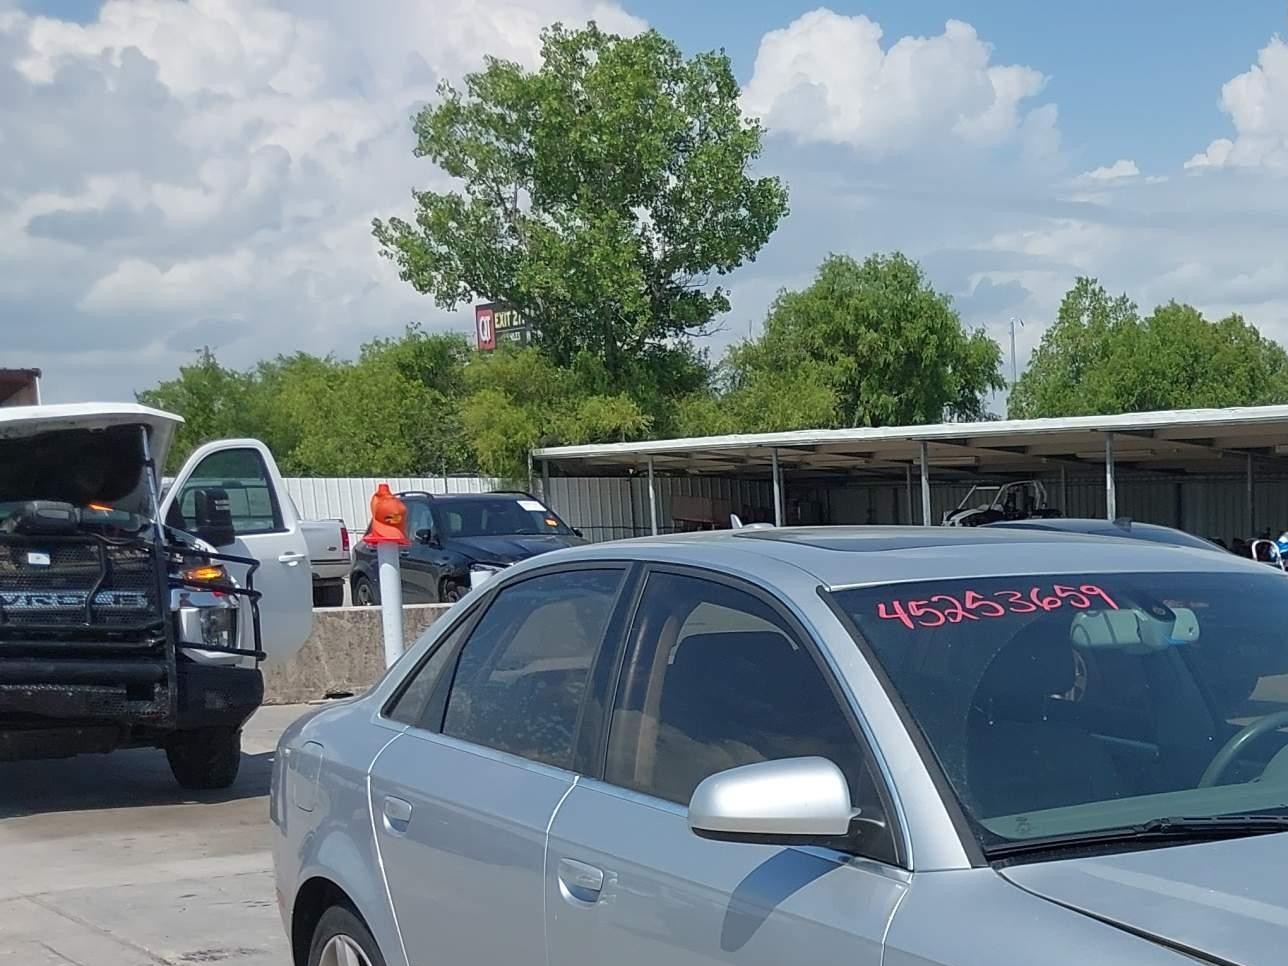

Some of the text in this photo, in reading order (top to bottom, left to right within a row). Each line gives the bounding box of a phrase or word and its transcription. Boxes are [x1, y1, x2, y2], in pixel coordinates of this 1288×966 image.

[479, 315, 491, 342] QT
[494, 310, 511, 329] EXIT
[877, 584, 1119, 630] 45253659
